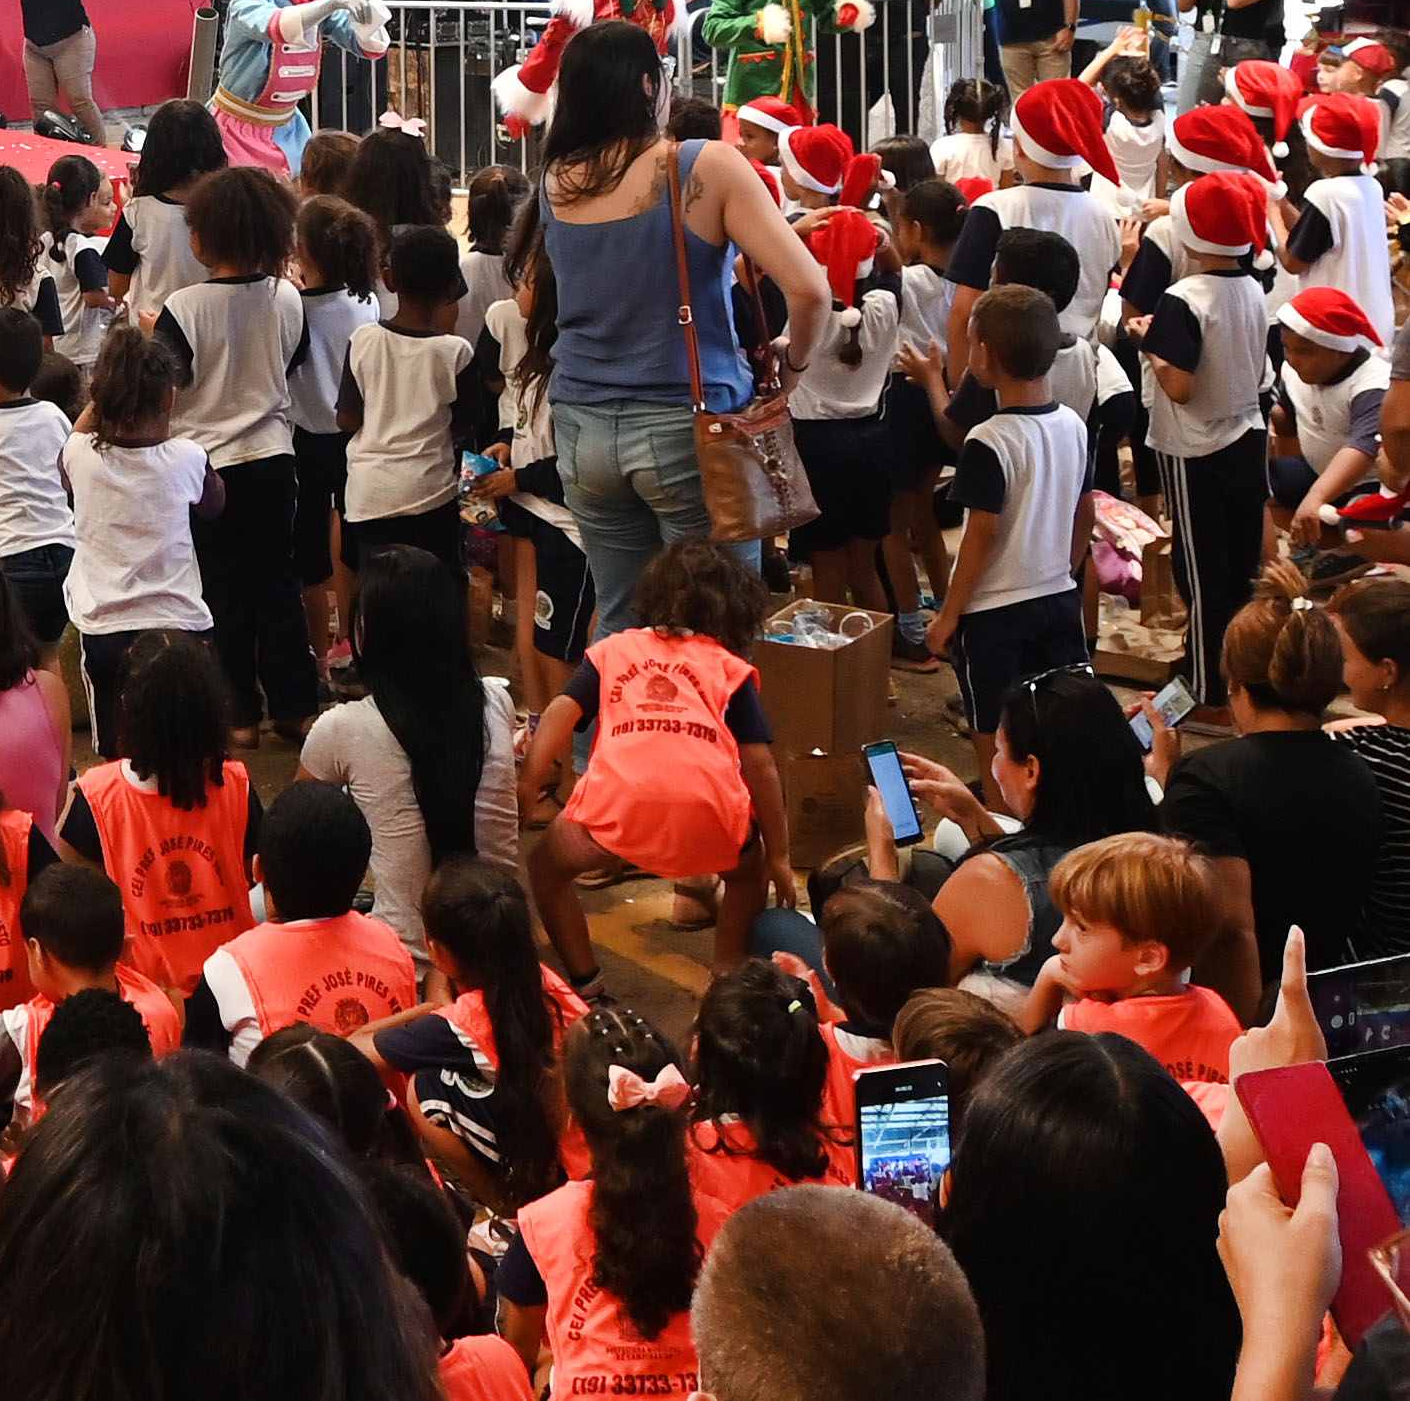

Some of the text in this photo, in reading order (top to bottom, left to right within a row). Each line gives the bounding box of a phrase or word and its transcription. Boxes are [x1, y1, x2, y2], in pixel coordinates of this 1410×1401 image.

[131, 877, 145, 898] CEI
[296, 983, 322, 1017] PREF
[322, 967, 354, 992] JOSÉ
[356, 971, 390, 999] PIRES
[1166, 1056, 1193, 1079] OSÉ
[567, 1277, 602, 1342] CEI PRE
[572, 1372, 699, 1395] (19) 33733-73
